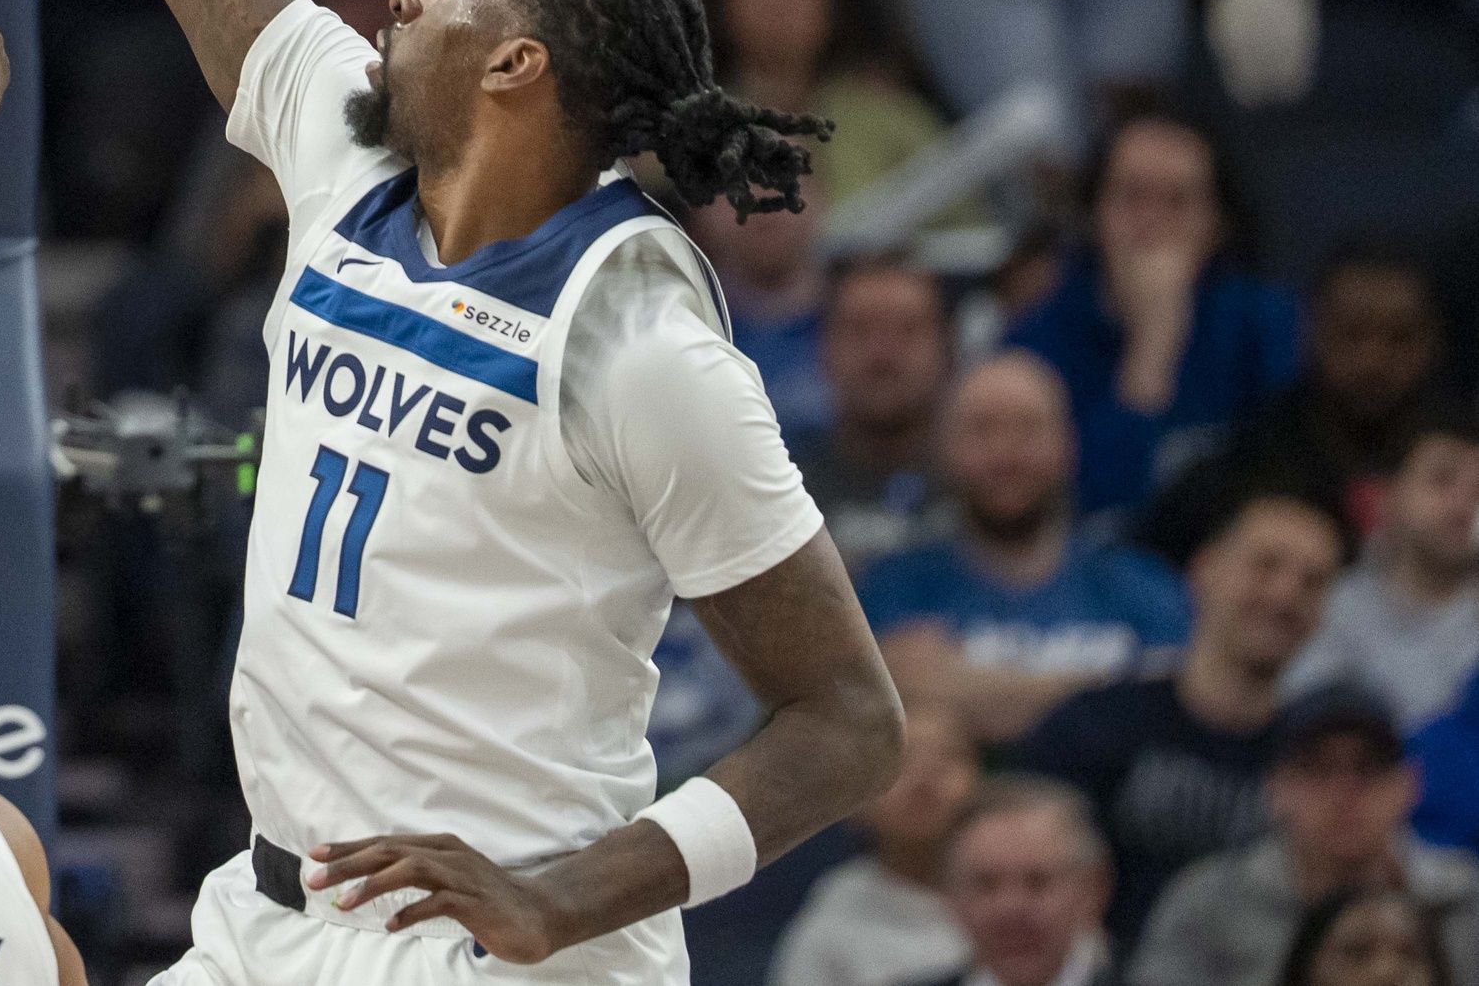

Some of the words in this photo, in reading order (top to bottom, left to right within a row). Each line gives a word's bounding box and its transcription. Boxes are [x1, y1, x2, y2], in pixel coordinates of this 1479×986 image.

[463, 305, 531, 343] sezzle
[285, 329, 512, 474] WOLVES
[286, 443, 390, 620] 11
